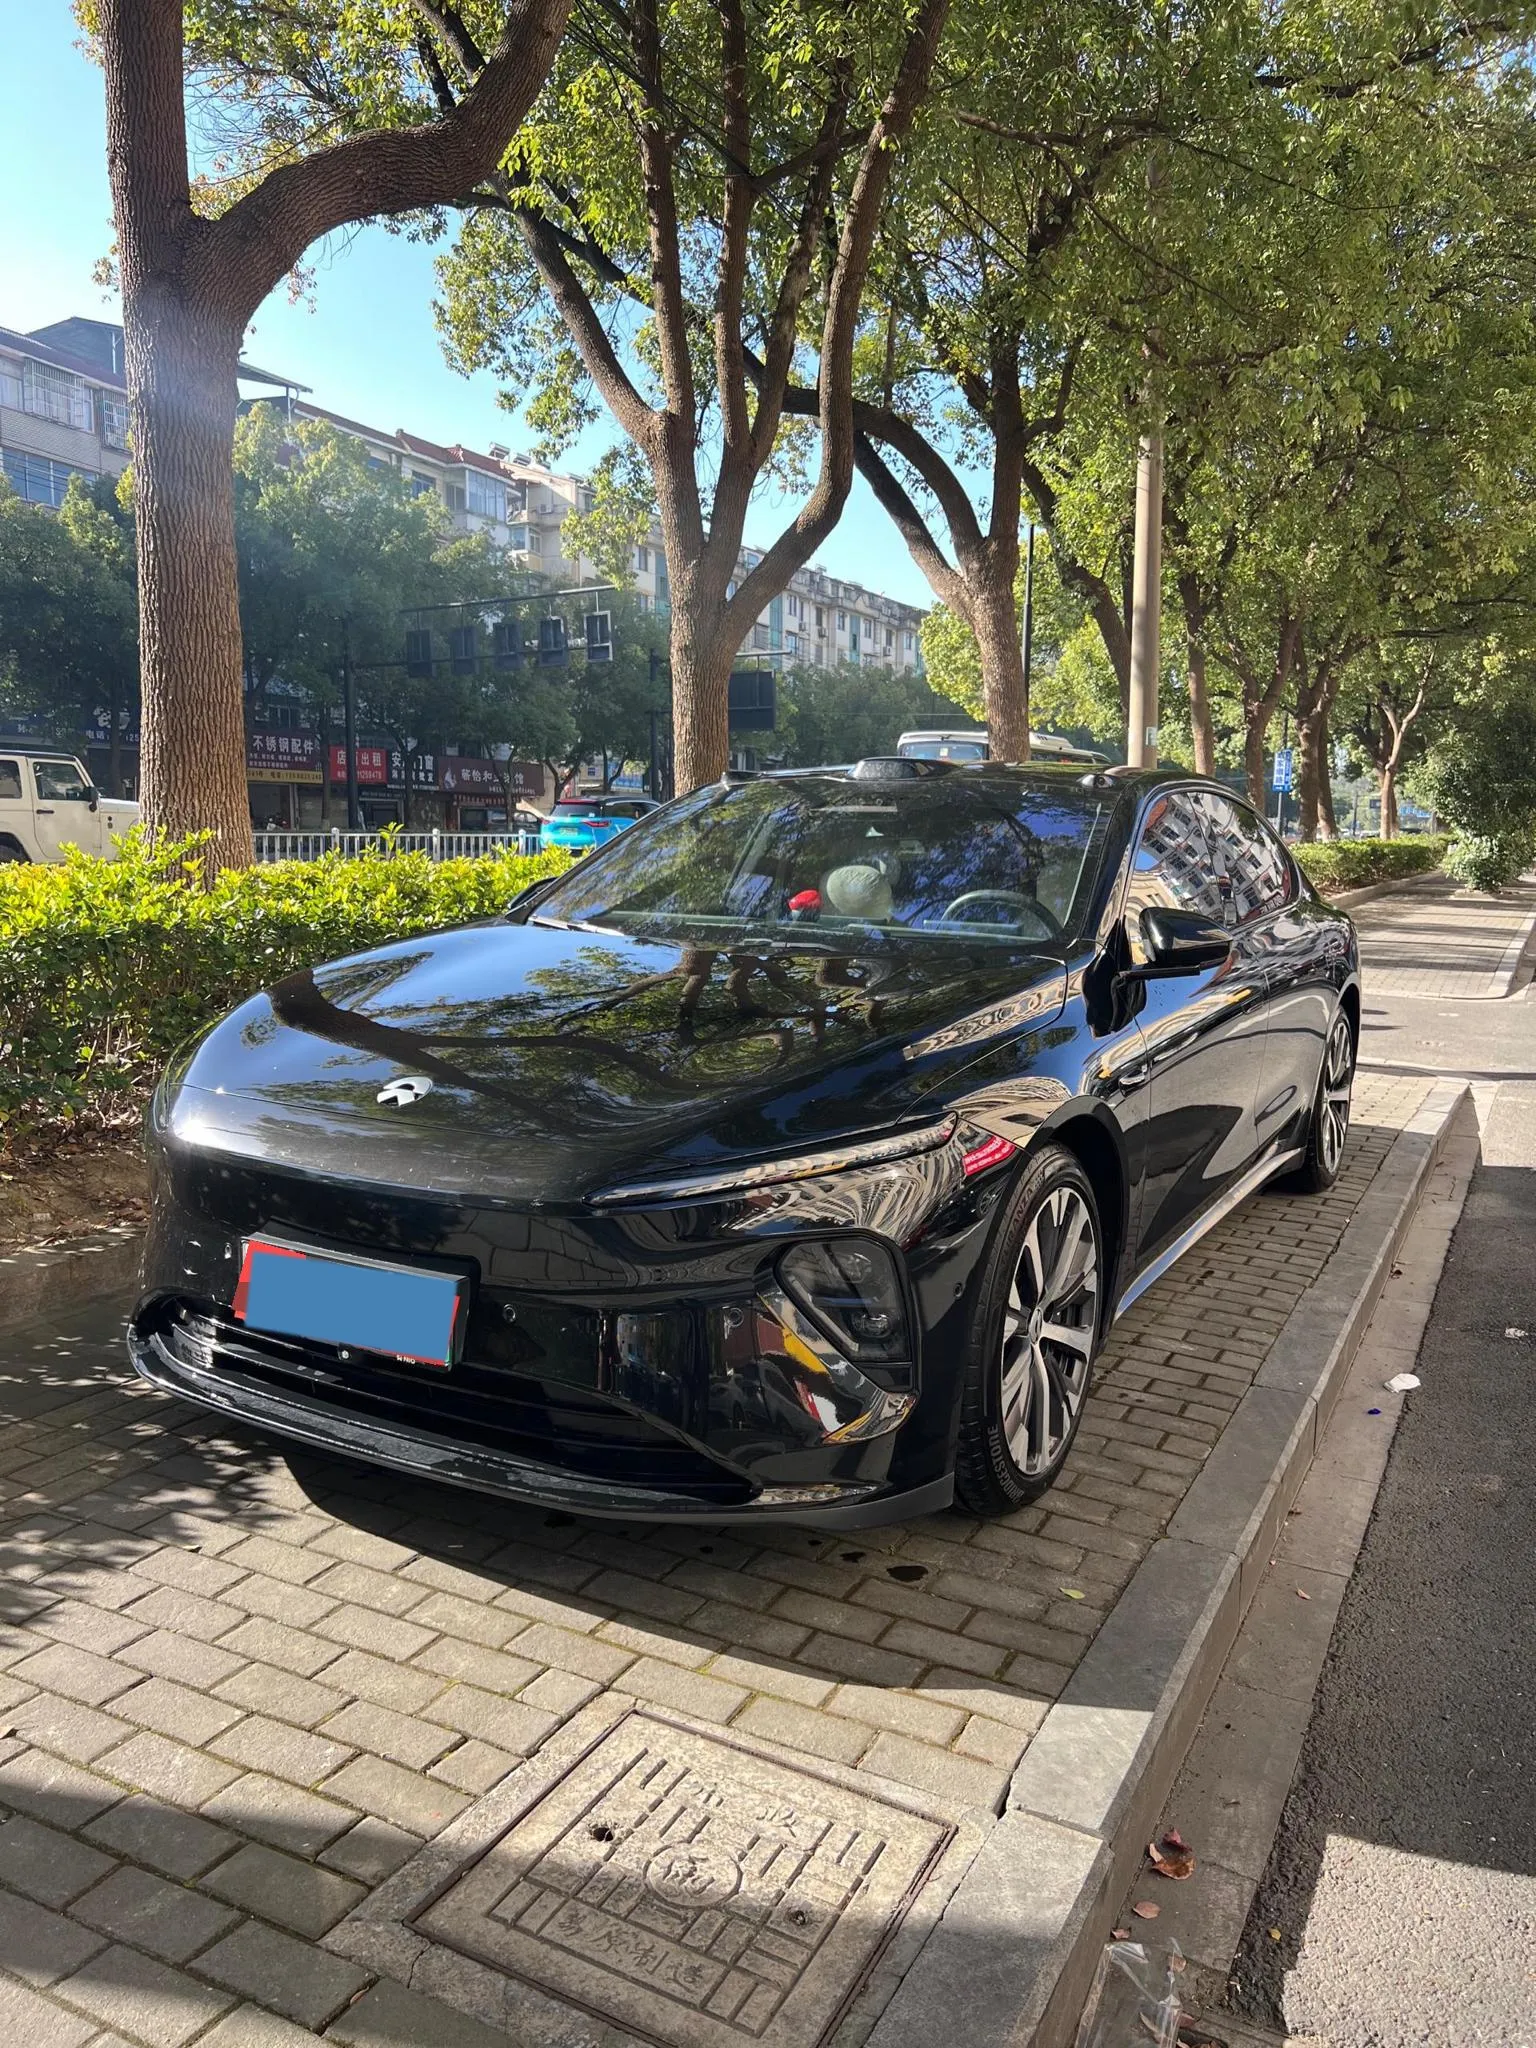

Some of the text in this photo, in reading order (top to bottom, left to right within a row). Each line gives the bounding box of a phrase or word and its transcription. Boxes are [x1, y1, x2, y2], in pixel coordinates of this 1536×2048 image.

[252, 734, 314, 755] 不锈钢配件
[337, 750, 382, 767] 店出租
[392, 752, 434, 771] 安门窗
[987, 1424, 1025, 1505] BRIDGESTONE
